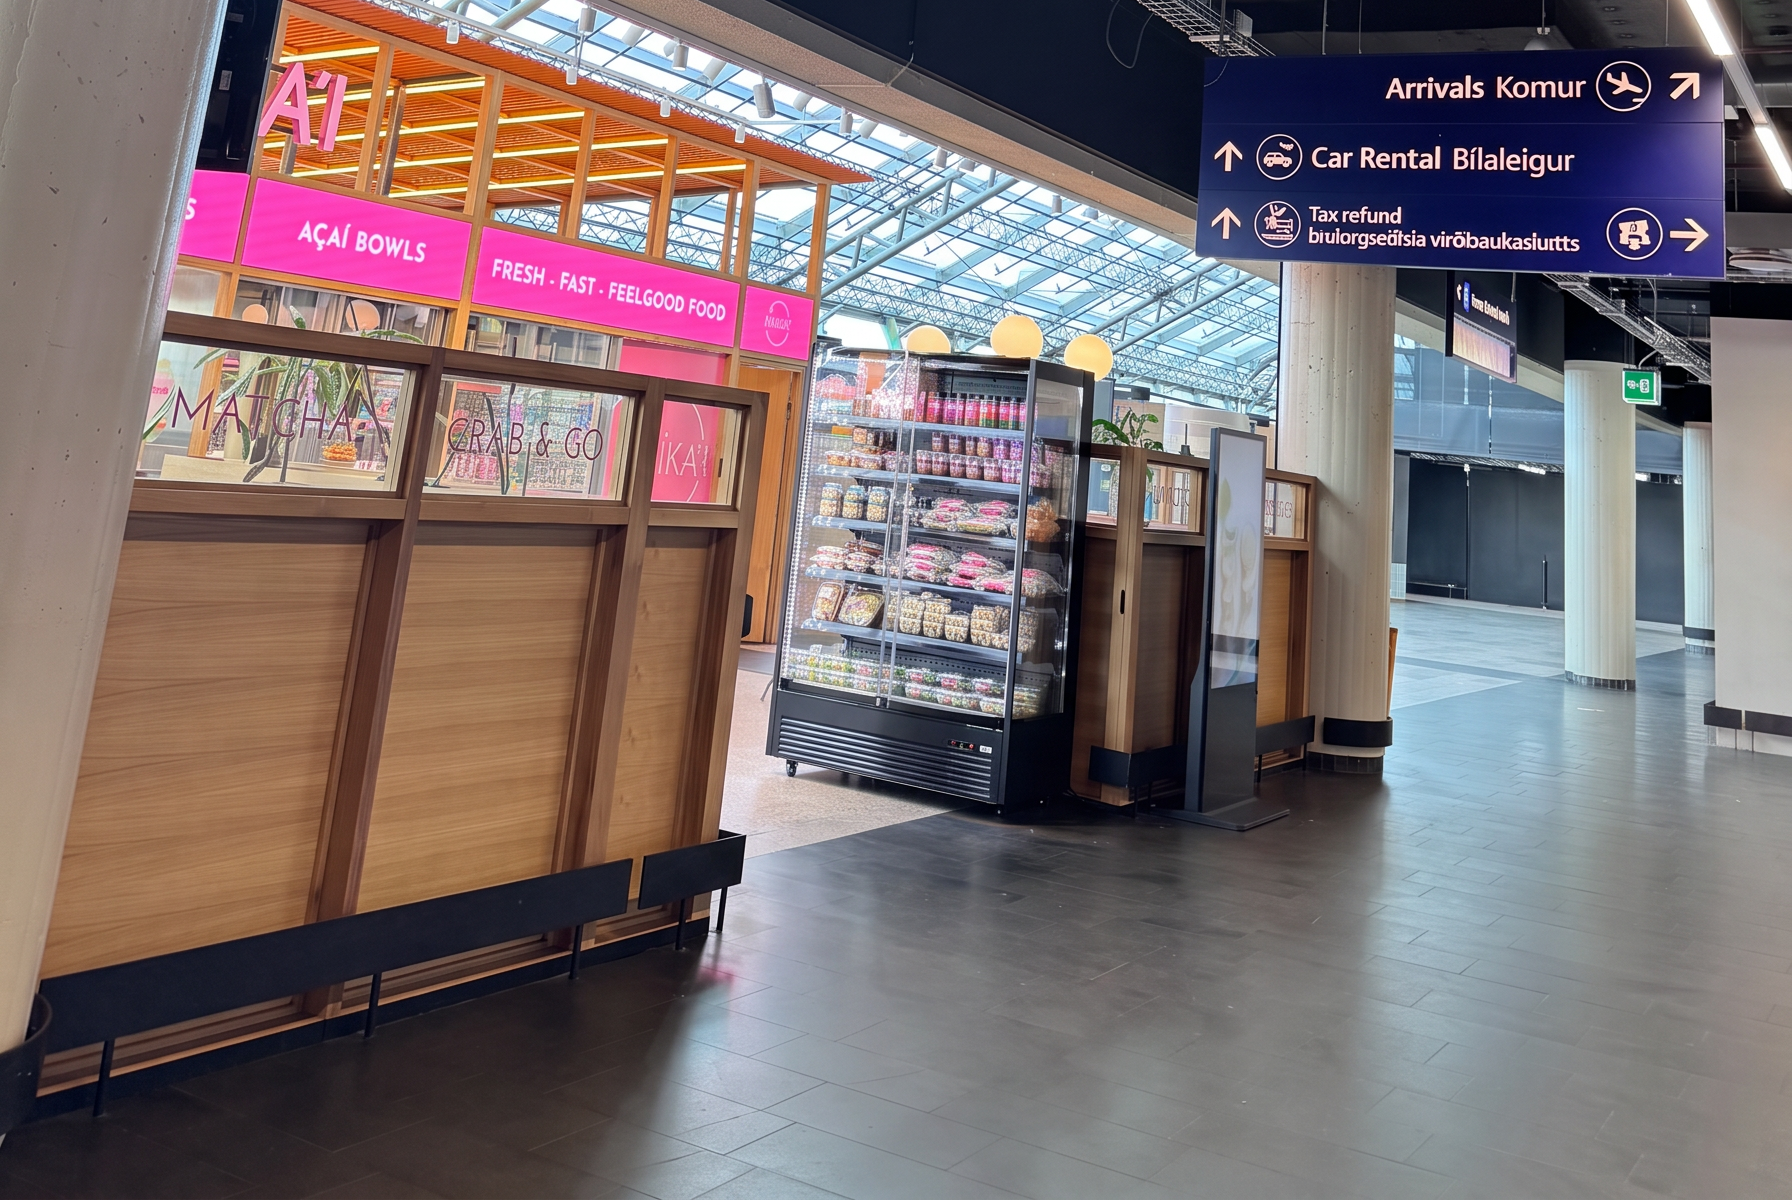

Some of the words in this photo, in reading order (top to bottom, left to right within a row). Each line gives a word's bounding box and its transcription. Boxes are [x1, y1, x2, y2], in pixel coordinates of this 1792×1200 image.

[1385, 75, 1485, 99] Arrivals
[1496, 76, 1587, 99] Komur
[1311, 146, 1353, 169] Car
[1360, 145, 1441, 170] Rental
[1453, 147, 1575, 178] Bílaleigur
[1308, 206, 1339, 223] Tax
[1342, 206, 1402, 225] refund
[297, 220, 351, 251] AÇAÍ
[355, 231, 427, 263] BOWLS
[491, 258, 546, 286] FRESH
[559, 271, 597, 295] FAST
[608, 281, 685, 313] FEELGOOD
[688, 298, 726, 321] FOOD
[171, 386, 352, 442] MATCHA
[536, 422, 553, 458] &
[564, 427, 604, 461] GO
